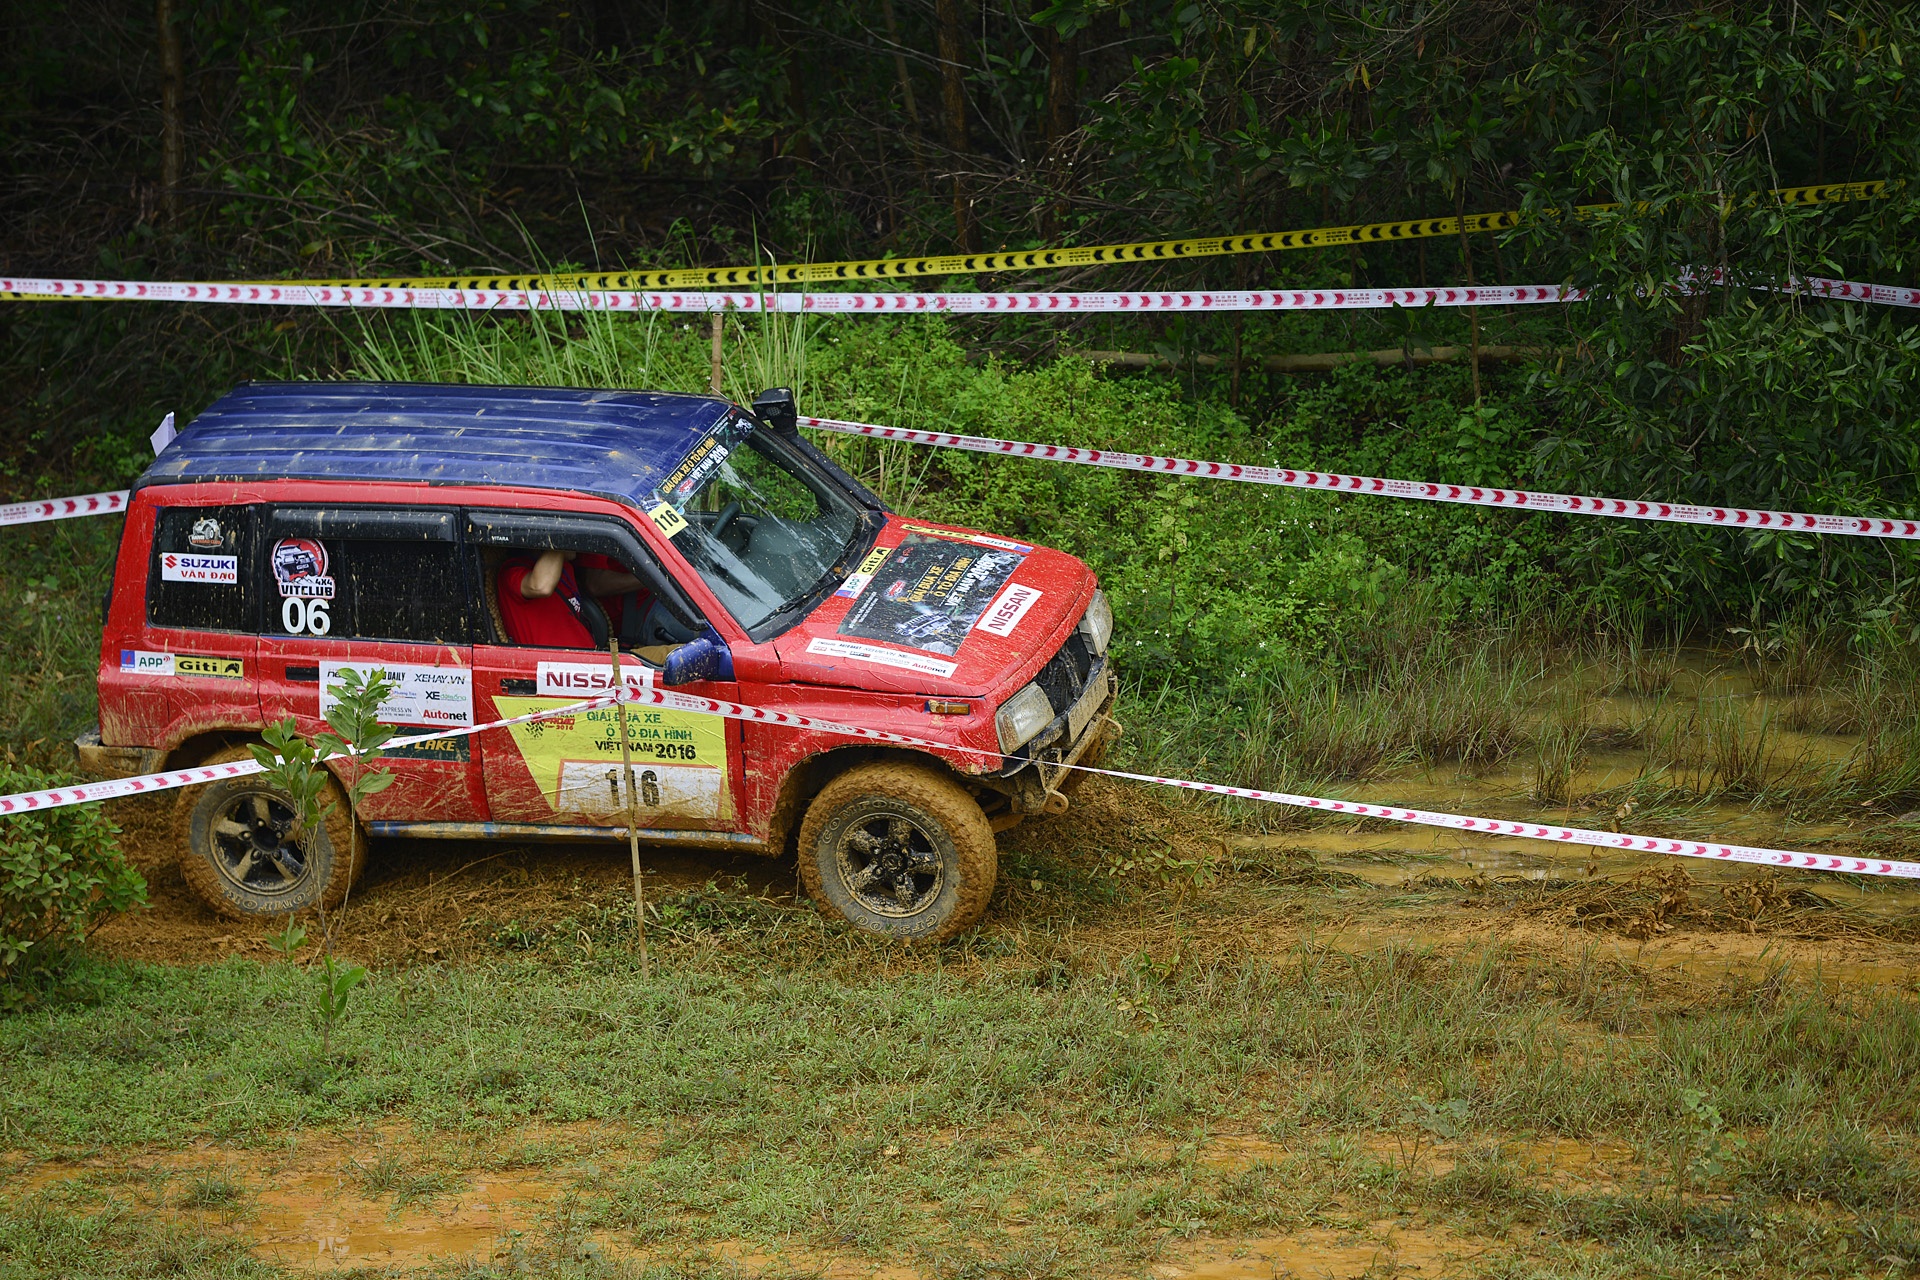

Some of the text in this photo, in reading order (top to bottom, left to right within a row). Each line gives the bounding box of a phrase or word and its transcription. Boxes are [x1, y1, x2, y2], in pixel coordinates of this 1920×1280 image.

[680, 465, 690, 474] XE
[654, 509, 680, 531] 116
[181, 558, 235, 569] SUZUKI
[862, 557, 880, 573] Giti
[929, 565, 944, 575] XE
[281, 585, 333, 596] VITCLUB
[988, 589, 1031, 630] NISSAN
[282, 597, 331, 635] 06
[179, 660, 218, 672] Giti
[912, 662, 946, 674] Autonet
[387, 671, 406, 681] DAILY
[414, 673, 465, 685] XEHAY.VN
[423, 709, 468, 721] Autonet
[586, 709, 611, 722] GIẢI
[644, 713, 662, 724] XE
[606, 723, 615, 737] Ô
[638, 728, 661, 741] ĐỊA
[664, 726, 693, 740] HÌNH
[414, 739, 457, 751] LAKE
[595, 737, 696, 760] VIỆT NAM 2016
